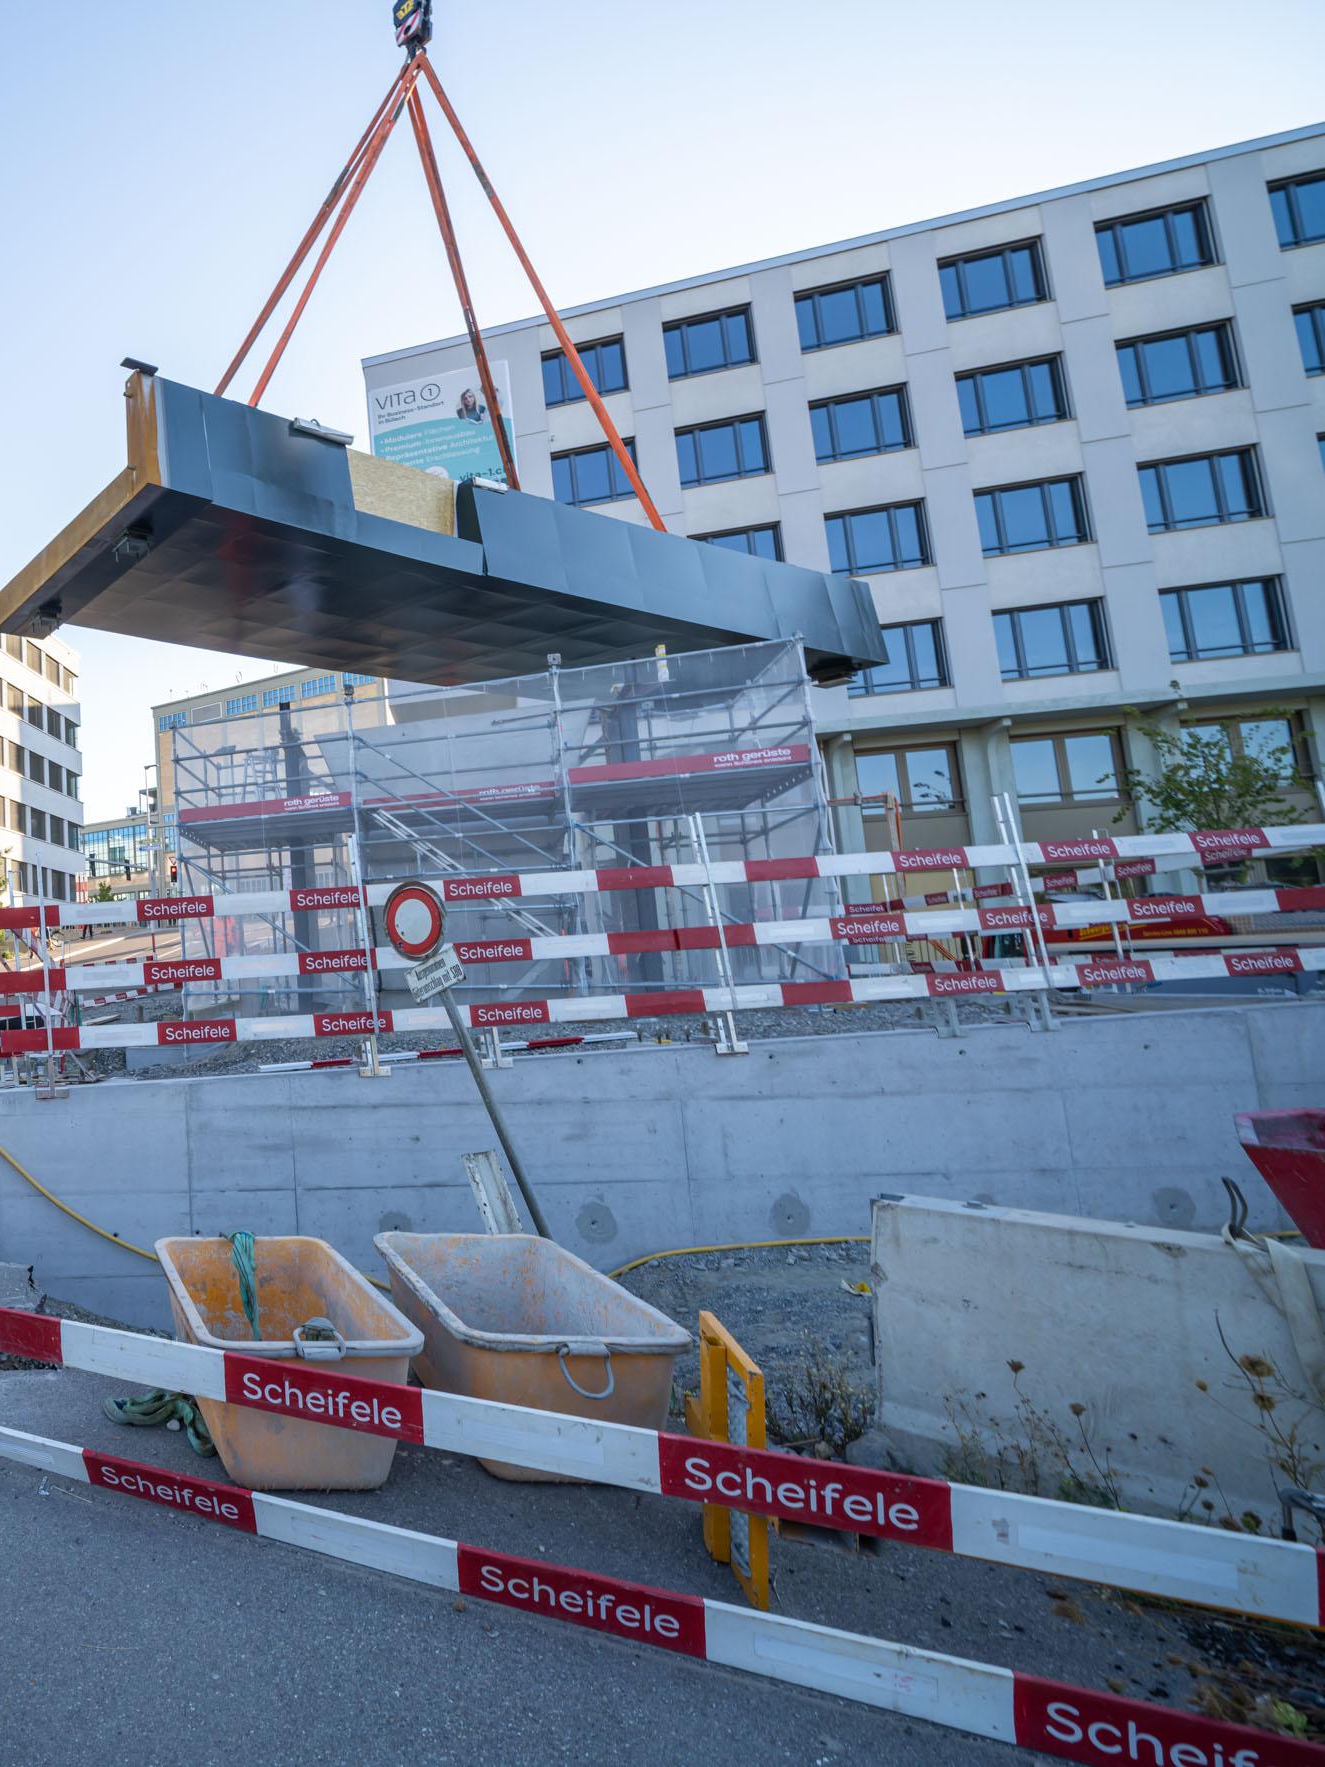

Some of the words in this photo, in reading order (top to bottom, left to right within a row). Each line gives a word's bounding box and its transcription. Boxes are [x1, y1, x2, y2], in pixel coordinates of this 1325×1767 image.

[714, 753, 739, 763] roth
[742, 748, 792, 762] gerüste
[1197, 833, 1261, 848] Scheifele
[1048, 843, 1110, 858] Scheifele
[900, 853, 963, 868] Scheifele
[450, 881, 512, 896] Scheifele
[297, 891, 360, 906] Scheifele
[144, 903, 207, 917] Scheifele
[849, 905, 884, 913] Scheifel
[1133, 901, 1196, 916] Scheifele
[838, 921, 900, 935] Scheifele
[460, 944, 523, 959] Scheifele
[306, 956, 368, 970] Scheifele
[1231, 956, 1294, 971] Scheifele
[151, 965, 215, 979] Scheifele
[1084, 966, 1146, 982] Scheifele
[935, 976, 997, 991] Scheifele
[478, 1006, 542, 1022] Scheifele
[322, 1015, 385, 1032] Scheifee
[166, 1025, 230, 1041] Scheifele
[242, 1373, 402, 1430] Scheifele
[100, 1465, 240, 1521] Scheifele
[684, 1457, 920, 1531] Scheifele
[481, 1565, 680, 1638] Scheifele
